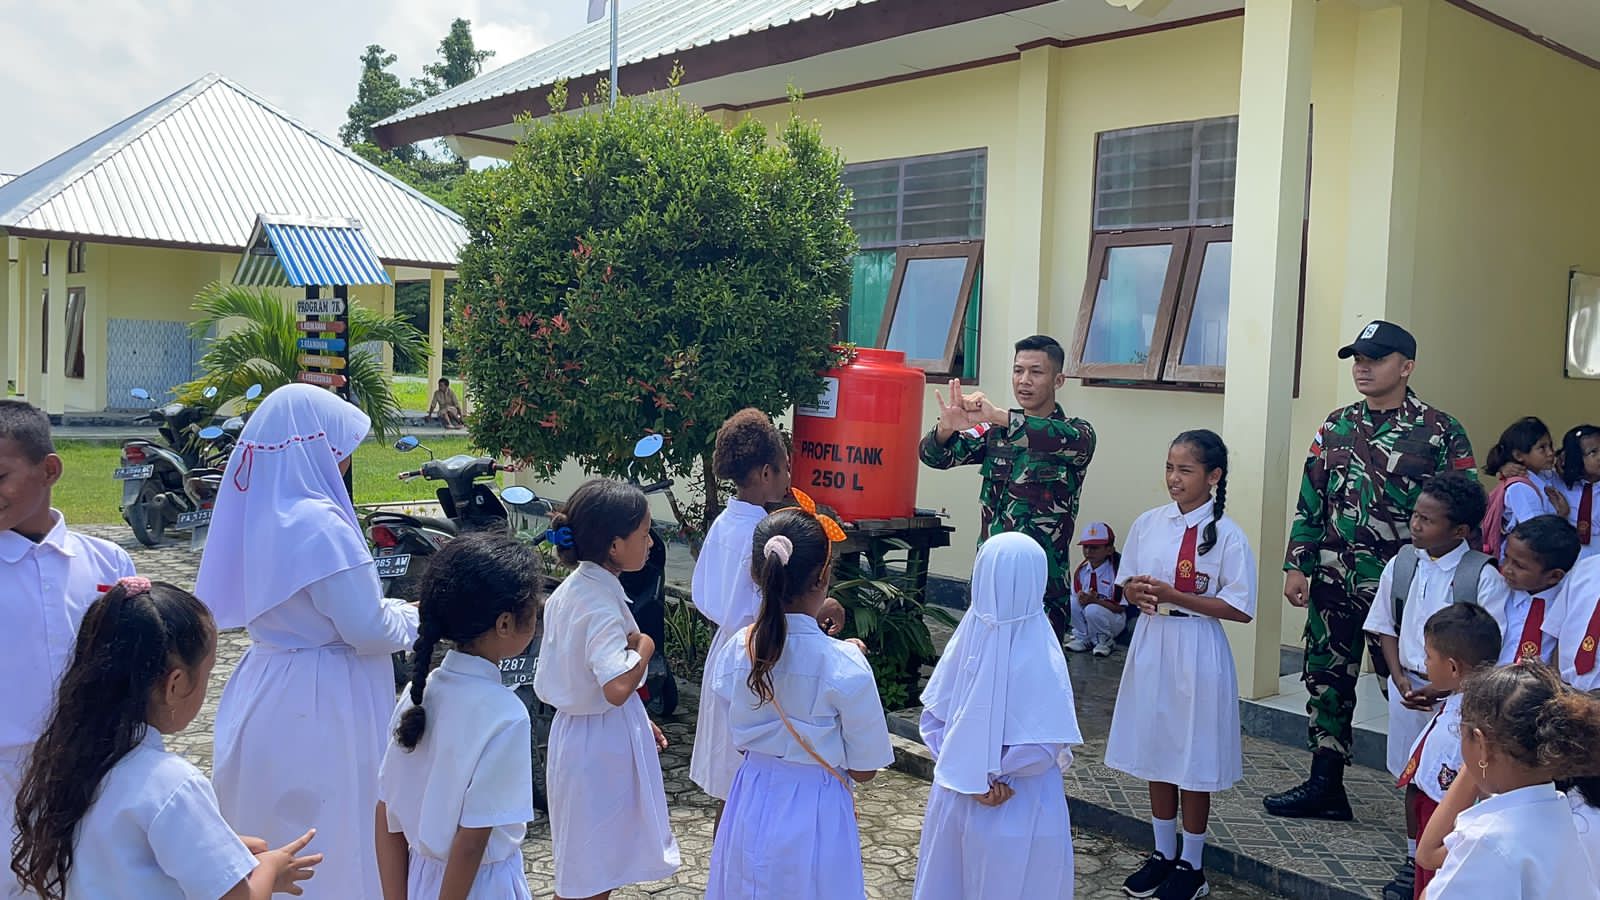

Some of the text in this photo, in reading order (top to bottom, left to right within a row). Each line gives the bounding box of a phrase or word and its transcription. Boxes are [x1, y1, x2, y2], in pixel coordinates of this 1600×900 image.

[297, 301, 341, 313] PROGRAM 7K
[801, 441, 884, 466] PROFIL TANK
[811, 469, 864, 491] 250 L
